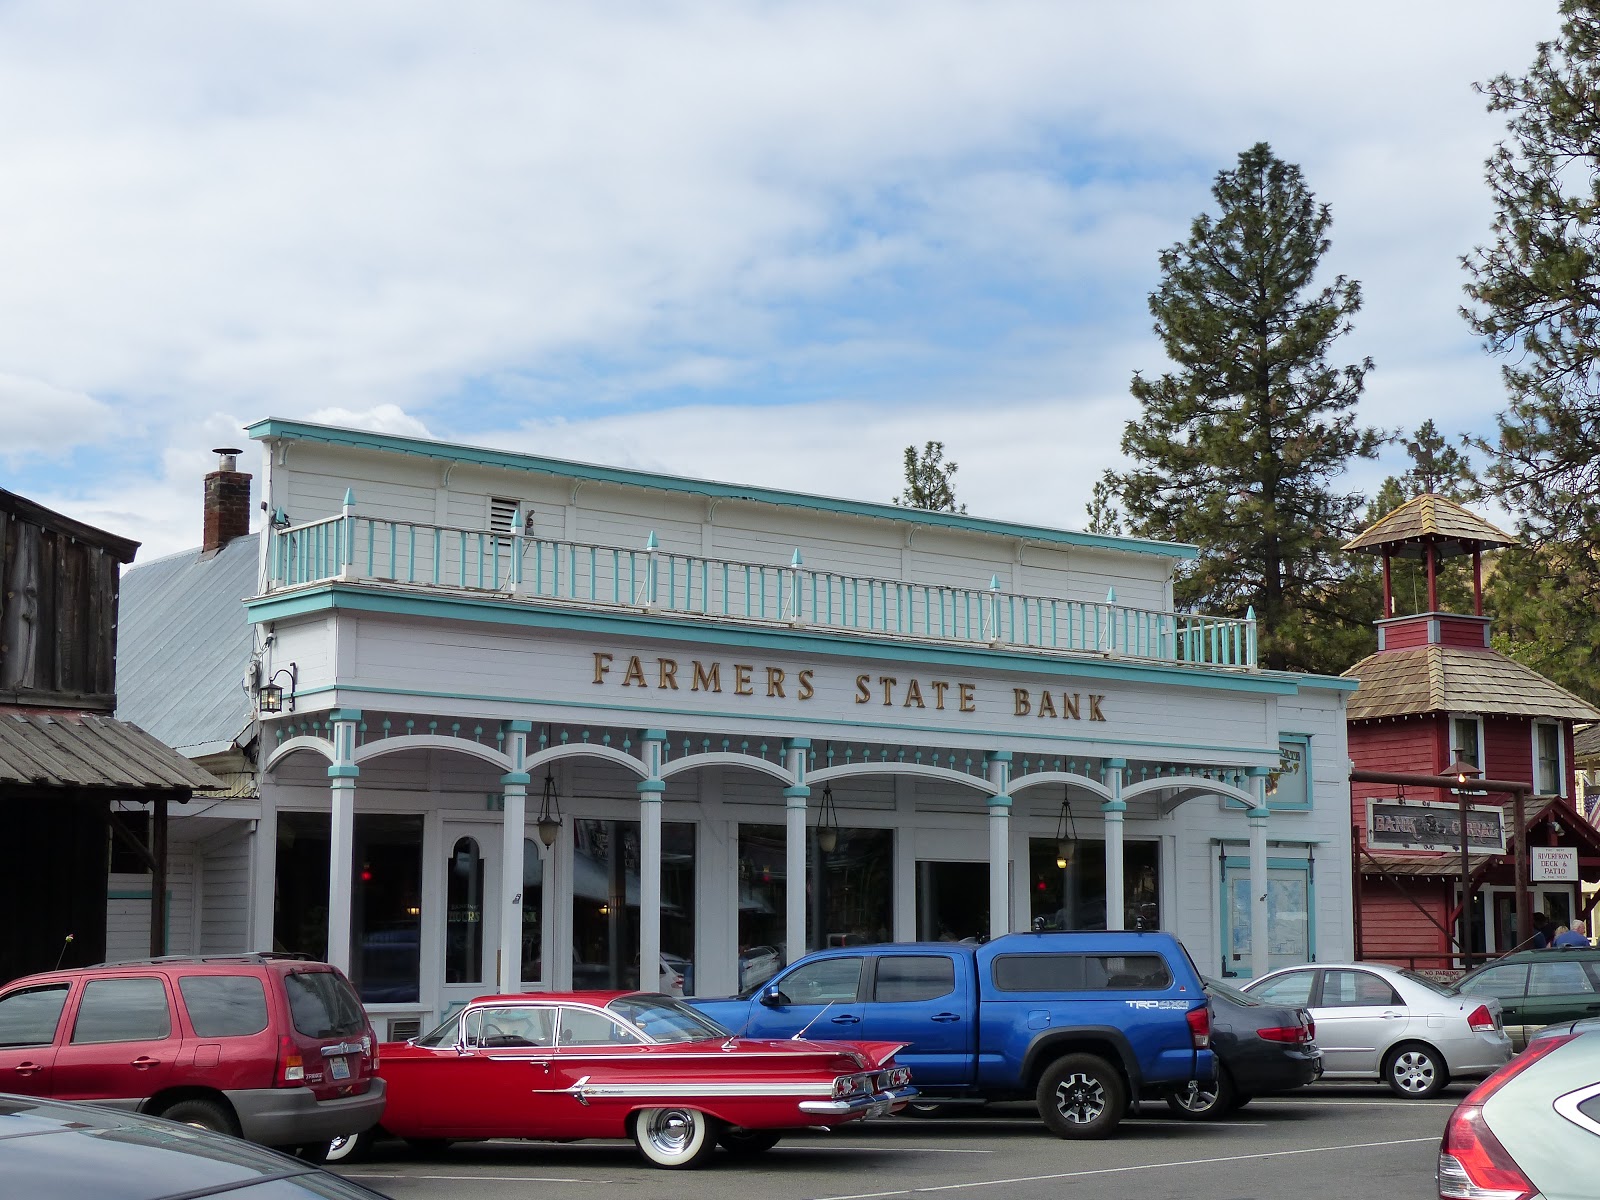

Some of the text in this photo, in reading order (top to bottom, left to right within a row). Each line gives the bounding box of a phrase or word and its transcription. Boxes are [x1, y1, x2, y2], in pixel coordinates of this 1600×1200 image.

[592, 651, 1107, 722] FARMERS STATE BANK
[1374, 814, 1422, 840] BANK
[1537, 852, 1573, 860] RIVERFRONT
[1544, 867, 1566, 875] PATIO
[1125, 1000, 1158, 1009] TRD
